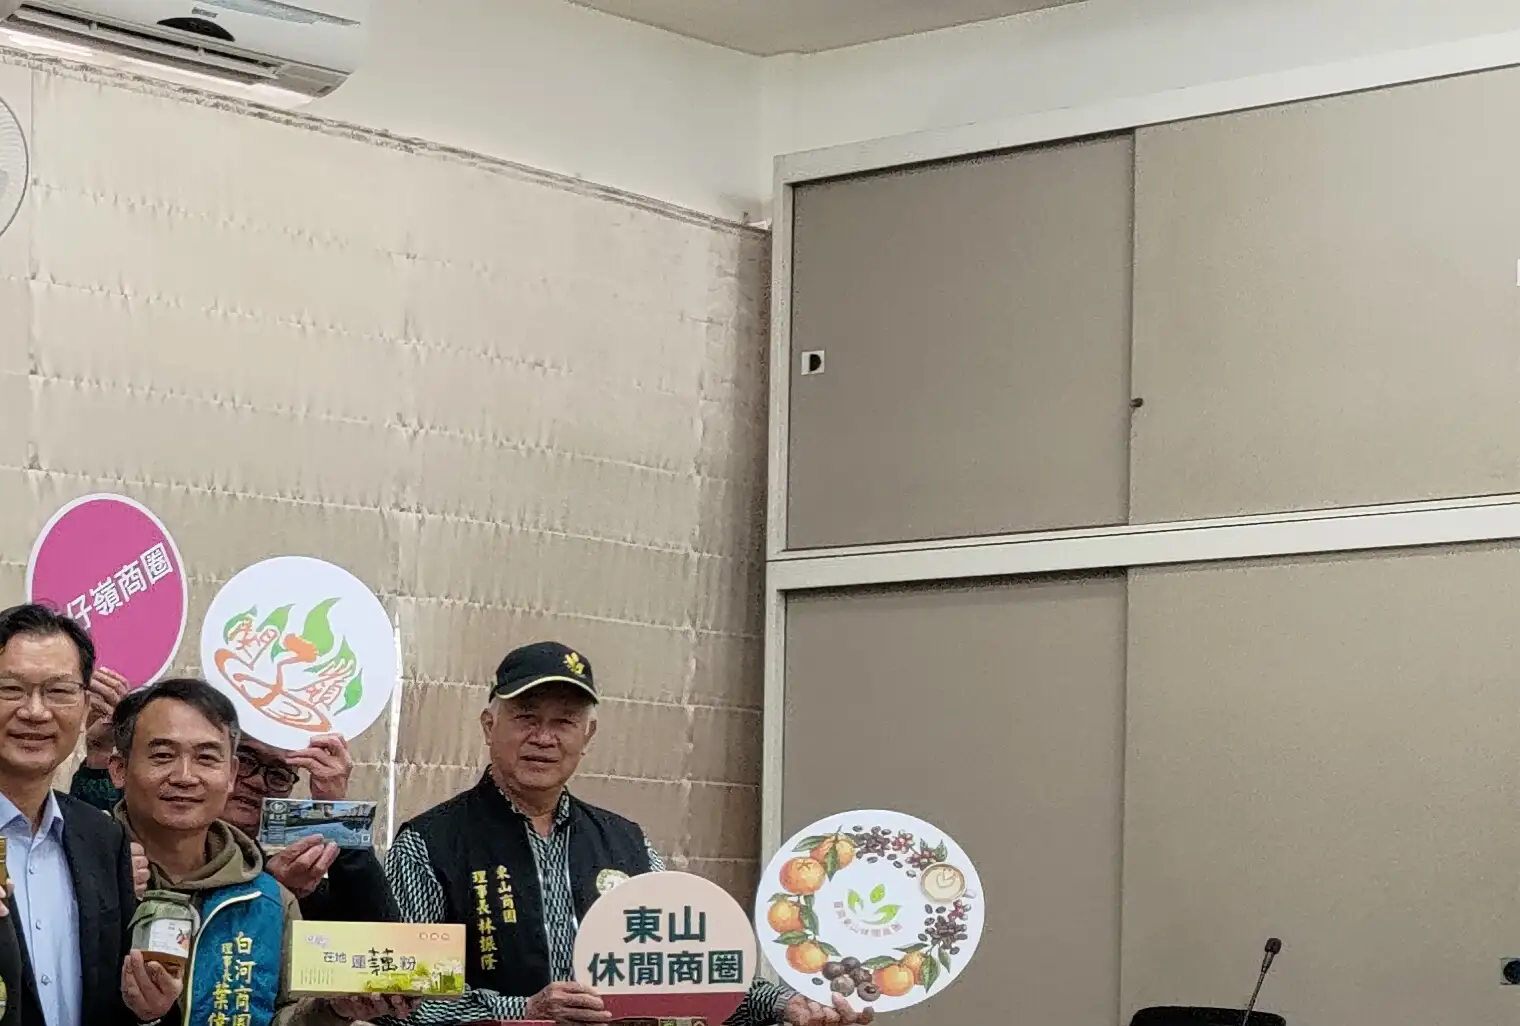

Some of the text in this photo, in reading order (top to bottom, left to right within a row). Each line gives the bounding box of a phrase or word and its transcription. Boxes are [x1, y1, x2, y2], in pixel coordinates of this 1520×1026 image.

[624, 905, 707, 944] 東山
[587, 950, 745, 987] 休閒商圈
